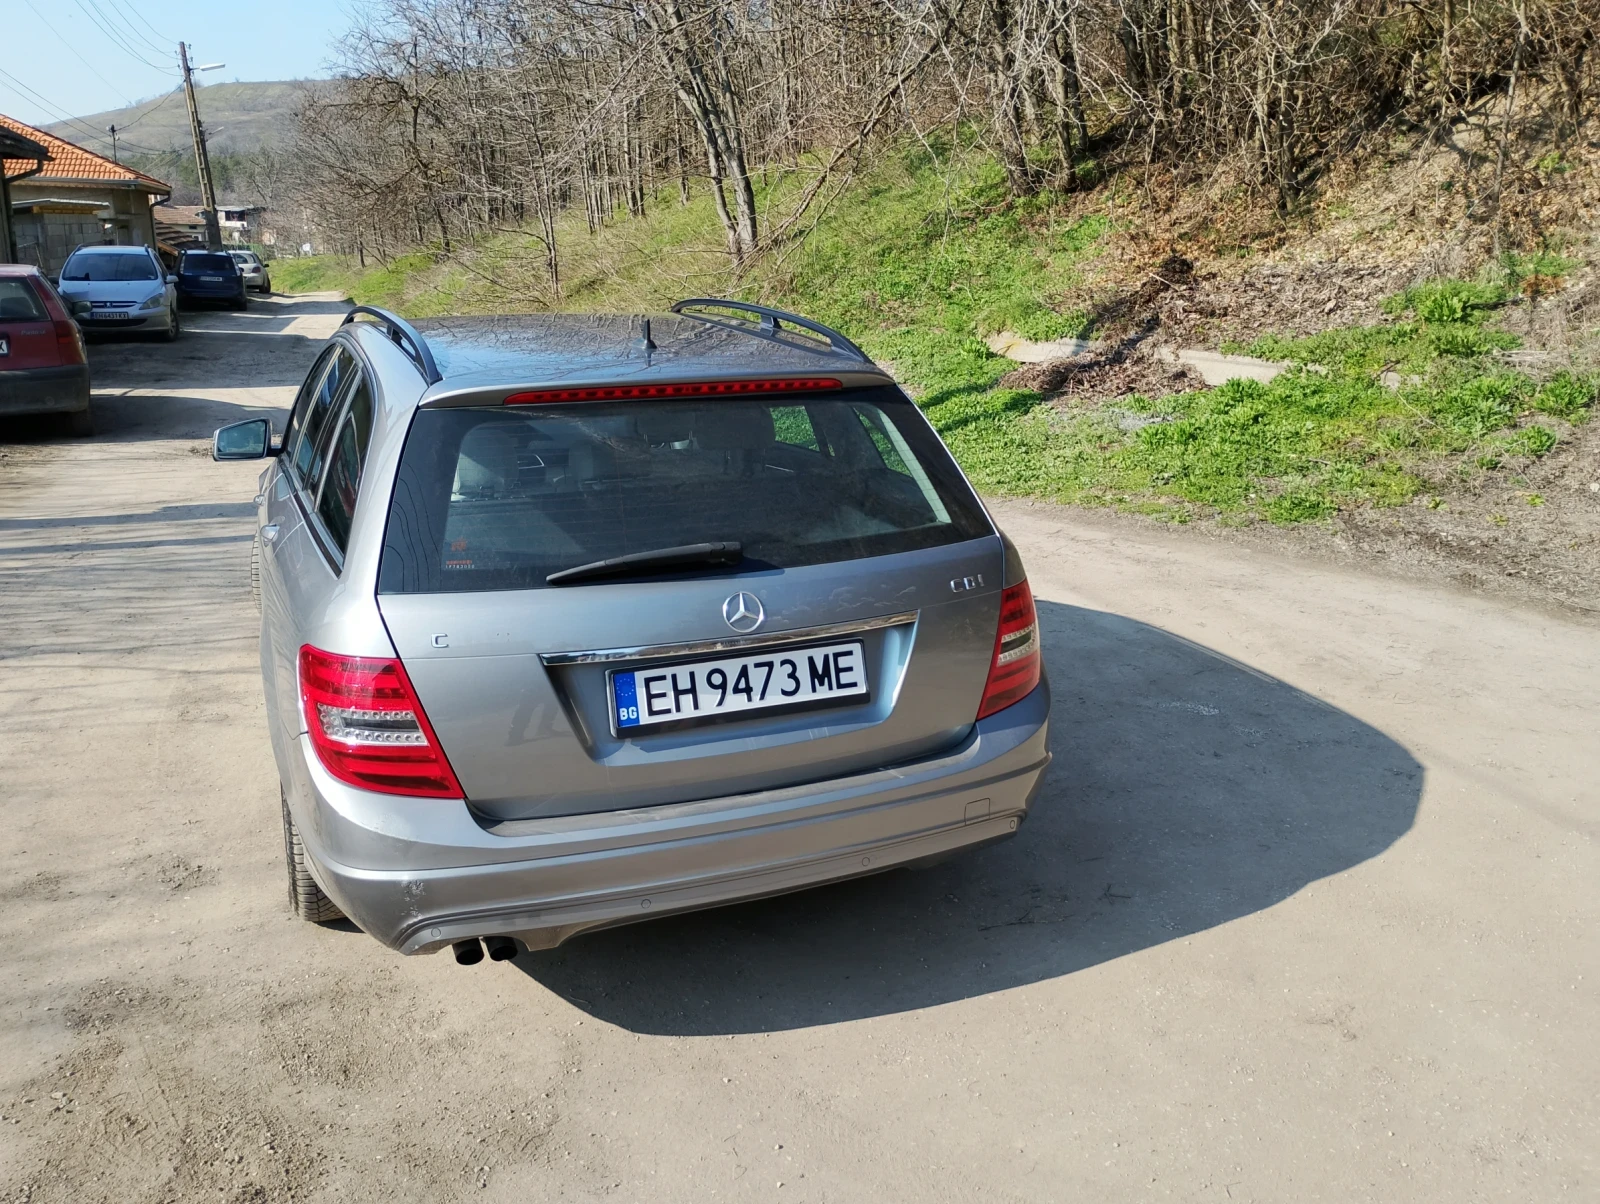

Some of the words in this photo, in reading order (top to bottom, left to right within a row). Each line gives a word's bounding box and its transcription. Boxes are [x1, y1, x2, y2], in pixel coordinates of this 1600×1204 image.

[950, 574, 984, 592] CDI
[431, 633, 449, 648] C
[619, 706, 638, 721] BG
